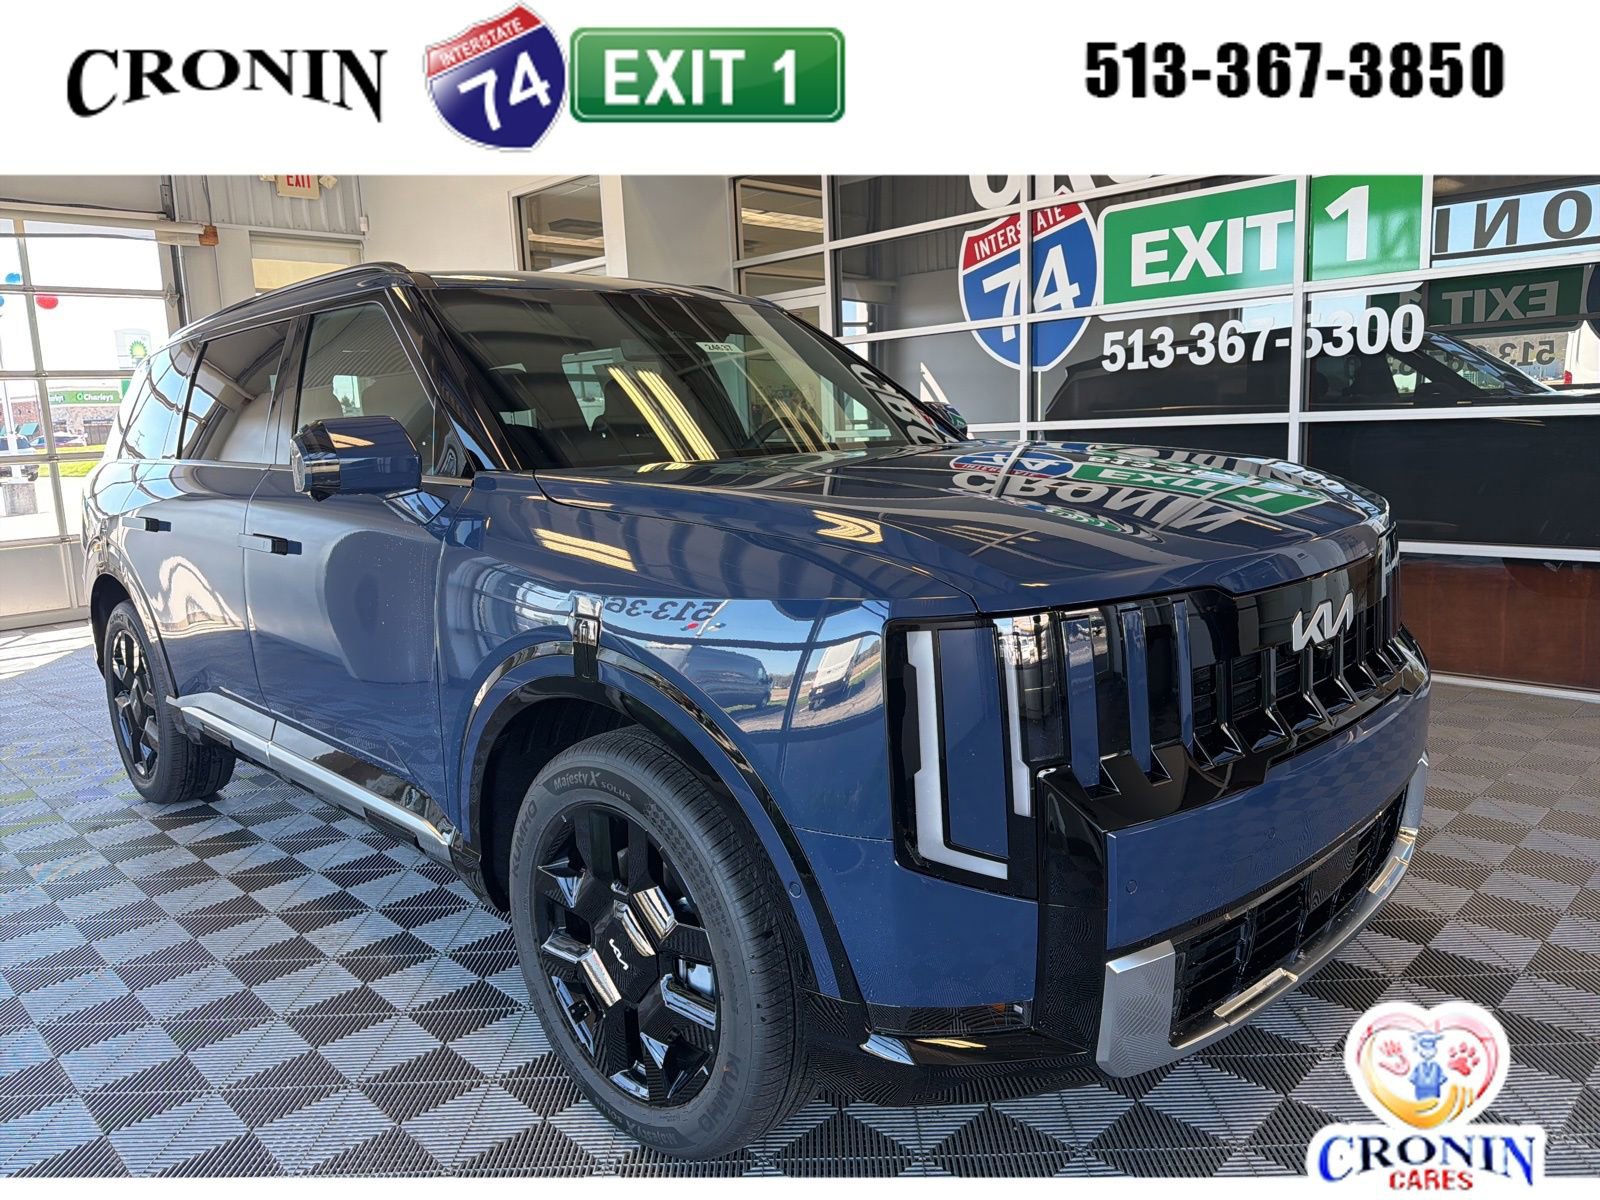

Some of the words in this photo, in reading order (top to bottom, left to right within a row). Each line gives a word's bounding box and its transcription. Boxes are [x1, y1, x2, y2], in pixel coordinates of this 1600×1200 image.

[1131, 209, 1294, 287] EXIT
[1324, 185, 1370, 262] 1
[982, 244, 1081, 343] 74
[553, 771, 590, 791] Majesty
[601, 781, 632, 802] SOLUS
[511, 799, 538, 879] KUMHO
[697, 1051, 742, 1134] KUMHO
